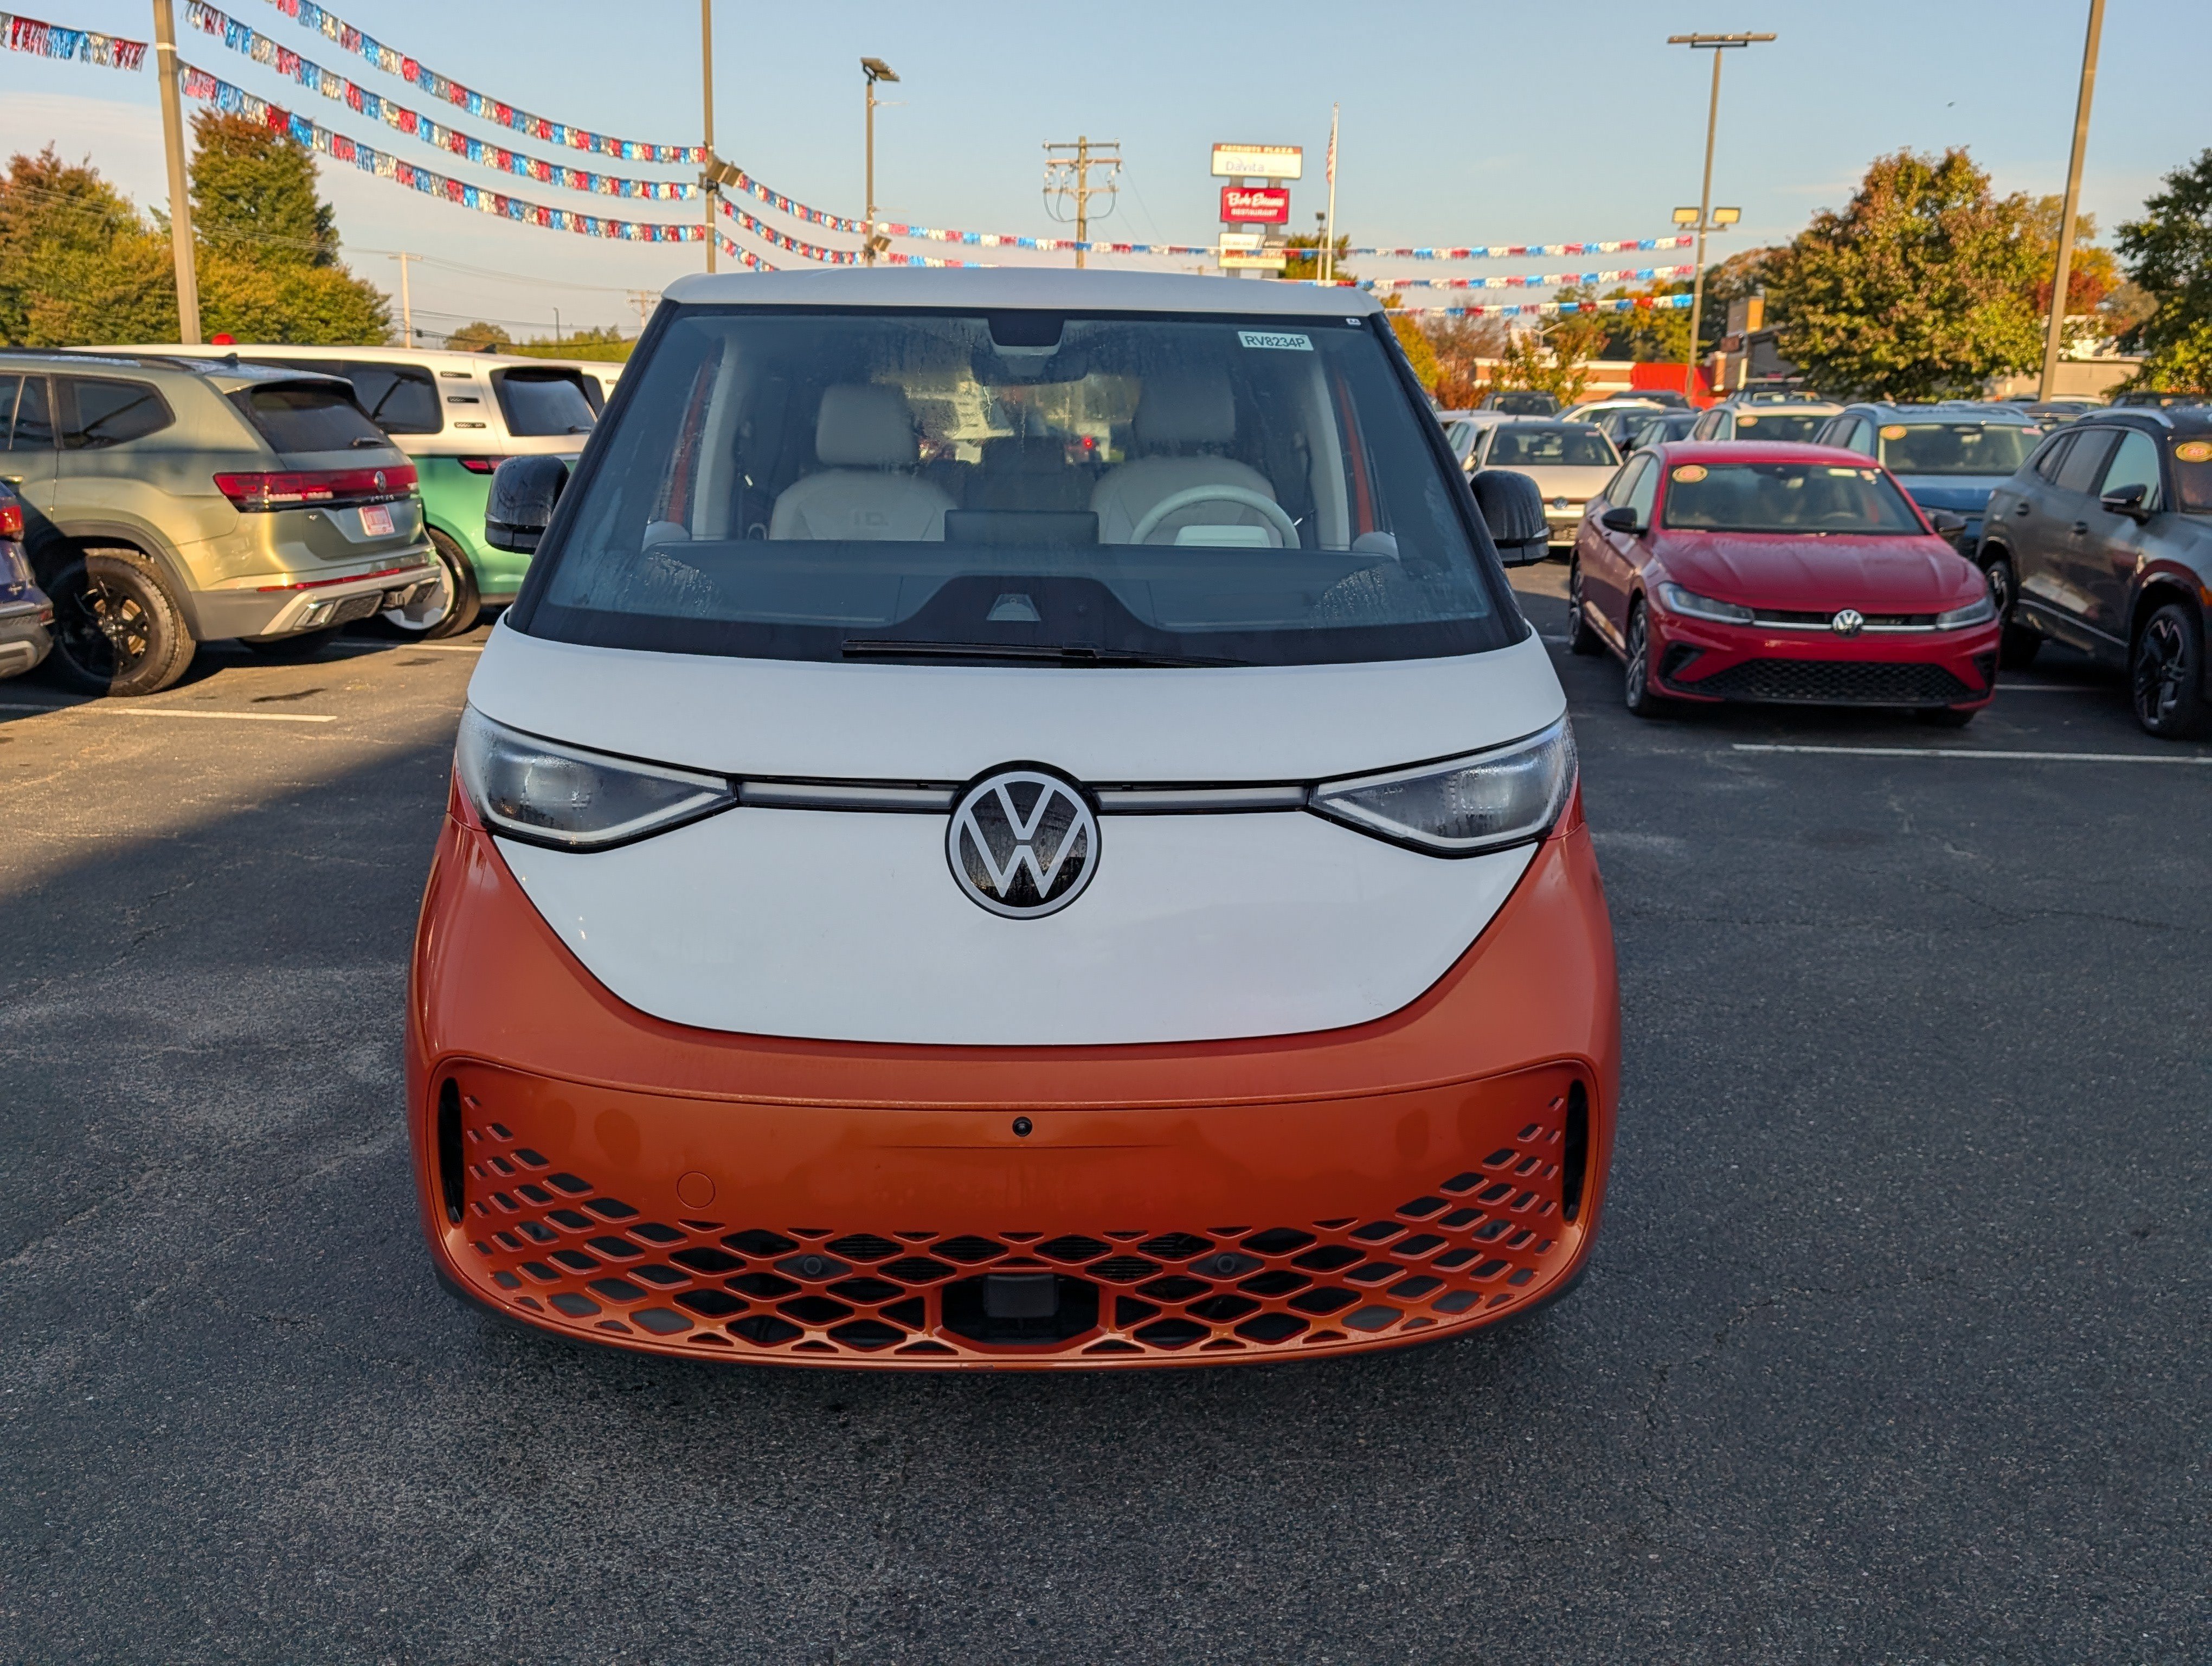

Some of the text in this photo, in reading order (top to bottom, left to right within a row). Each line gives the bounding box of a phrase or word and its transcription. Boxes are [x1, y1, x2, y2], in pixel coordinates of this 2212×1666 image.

[1226, 191, 1252, 207] Bob
[1245, 335, 1305, 348] RV8234P
[949, 770, 1098, 917] VW
